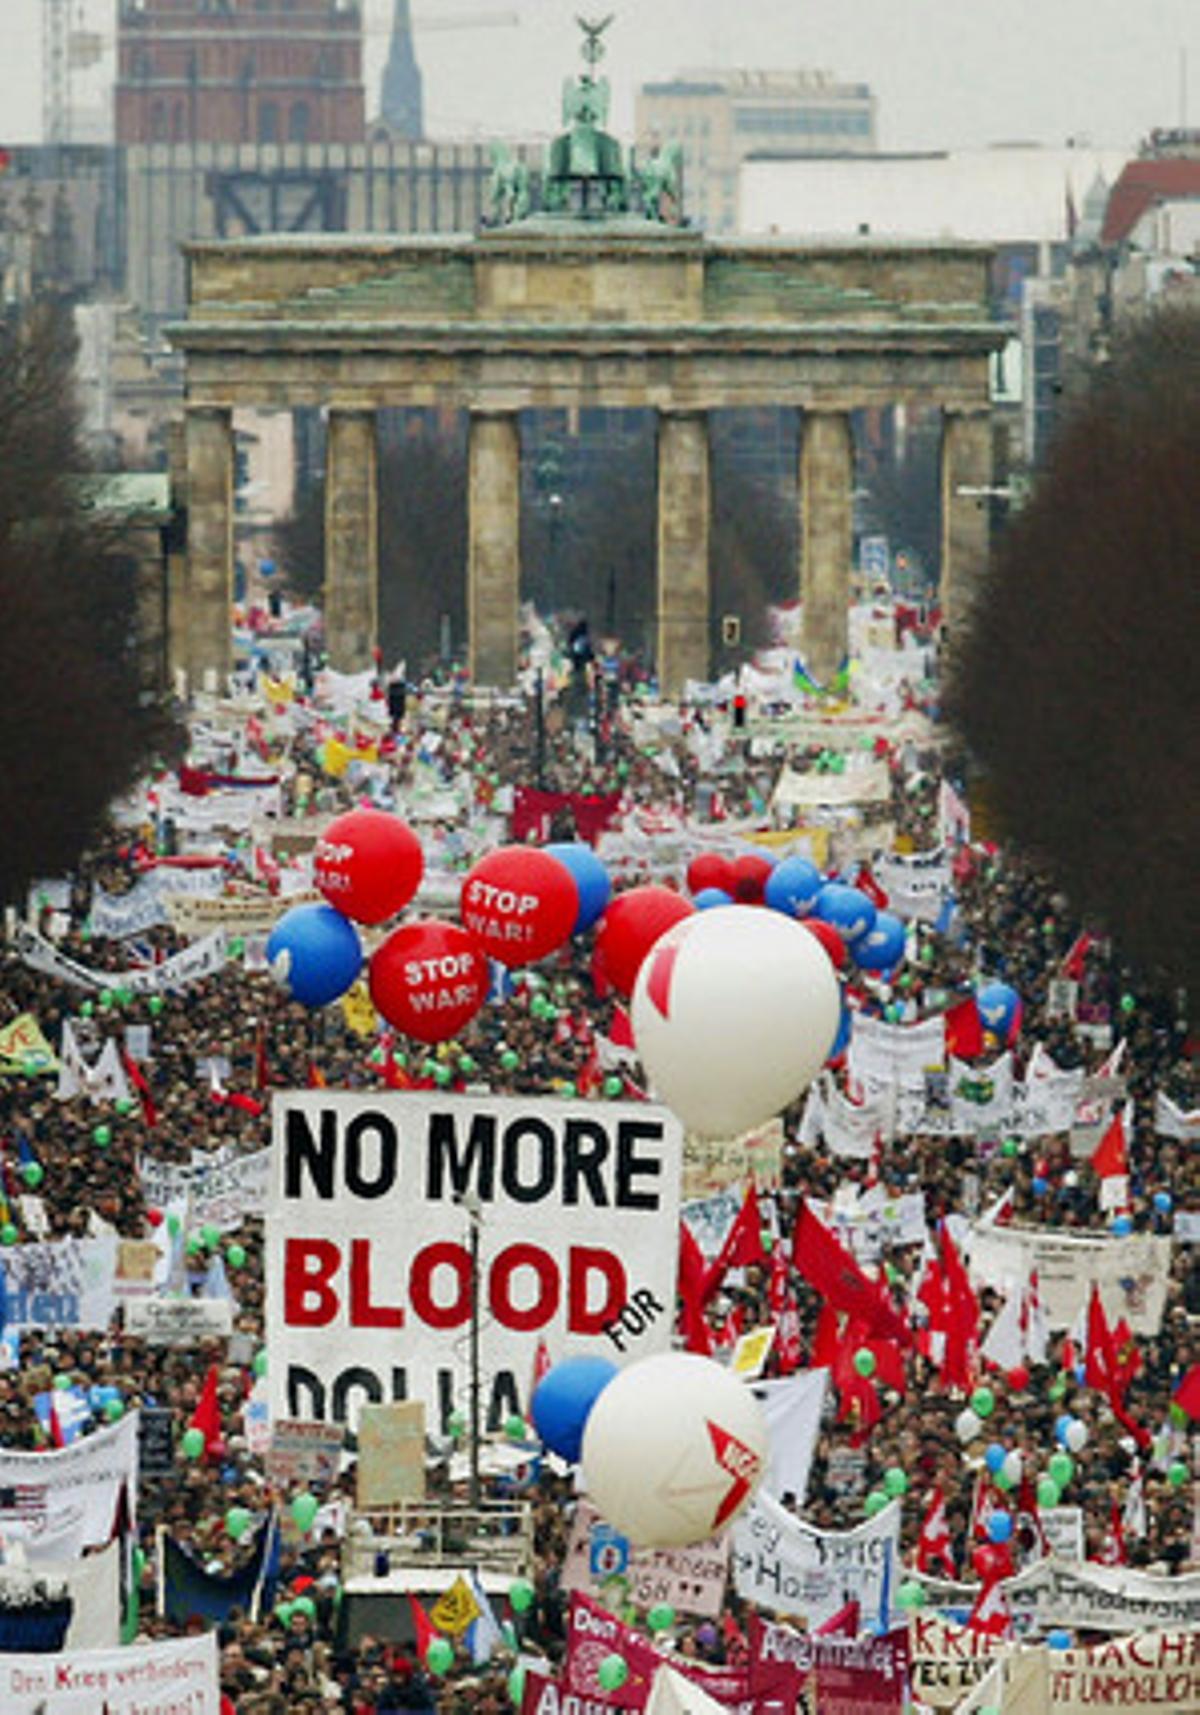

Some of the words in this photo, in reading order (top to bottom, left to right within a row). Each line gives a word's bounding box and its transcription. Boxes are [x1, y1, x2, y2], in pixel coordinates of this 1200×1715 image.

[468, 880, 539, 916] STOP
[465, 911, 534, 941] WAR!
[404, 953, 475, 985] STOP
[285, 1109, 398, 1200] NO
[426, 1112, 663, 1211] MORE
[284, 1238, 628, 1336] BLOOD
[603, 1288, 665, 1352] FOR
